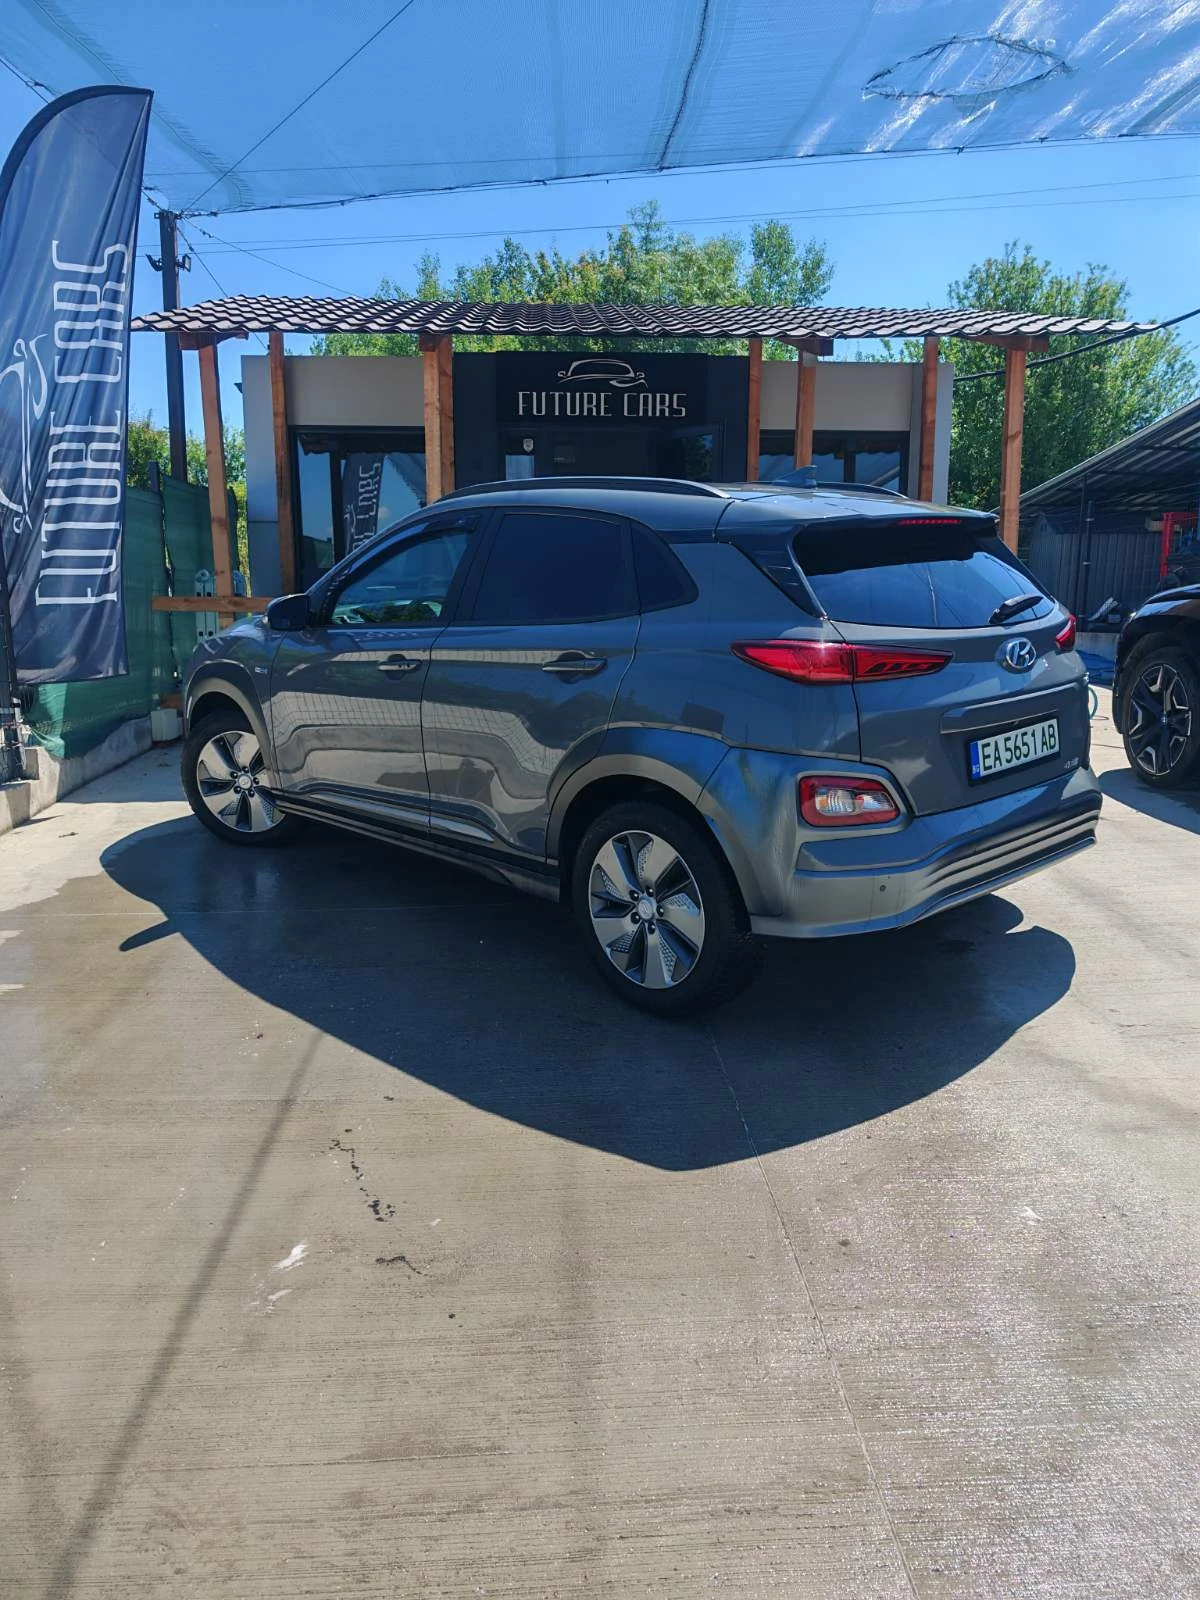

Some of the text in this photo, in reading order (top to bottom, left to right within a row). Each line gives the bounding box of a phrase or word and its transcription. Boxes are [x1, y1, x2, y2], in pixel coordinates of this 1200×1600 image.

[35, 240, 128, 606] FUTURE CARS
[518, 391, 687, 417] FUTURE CARS
